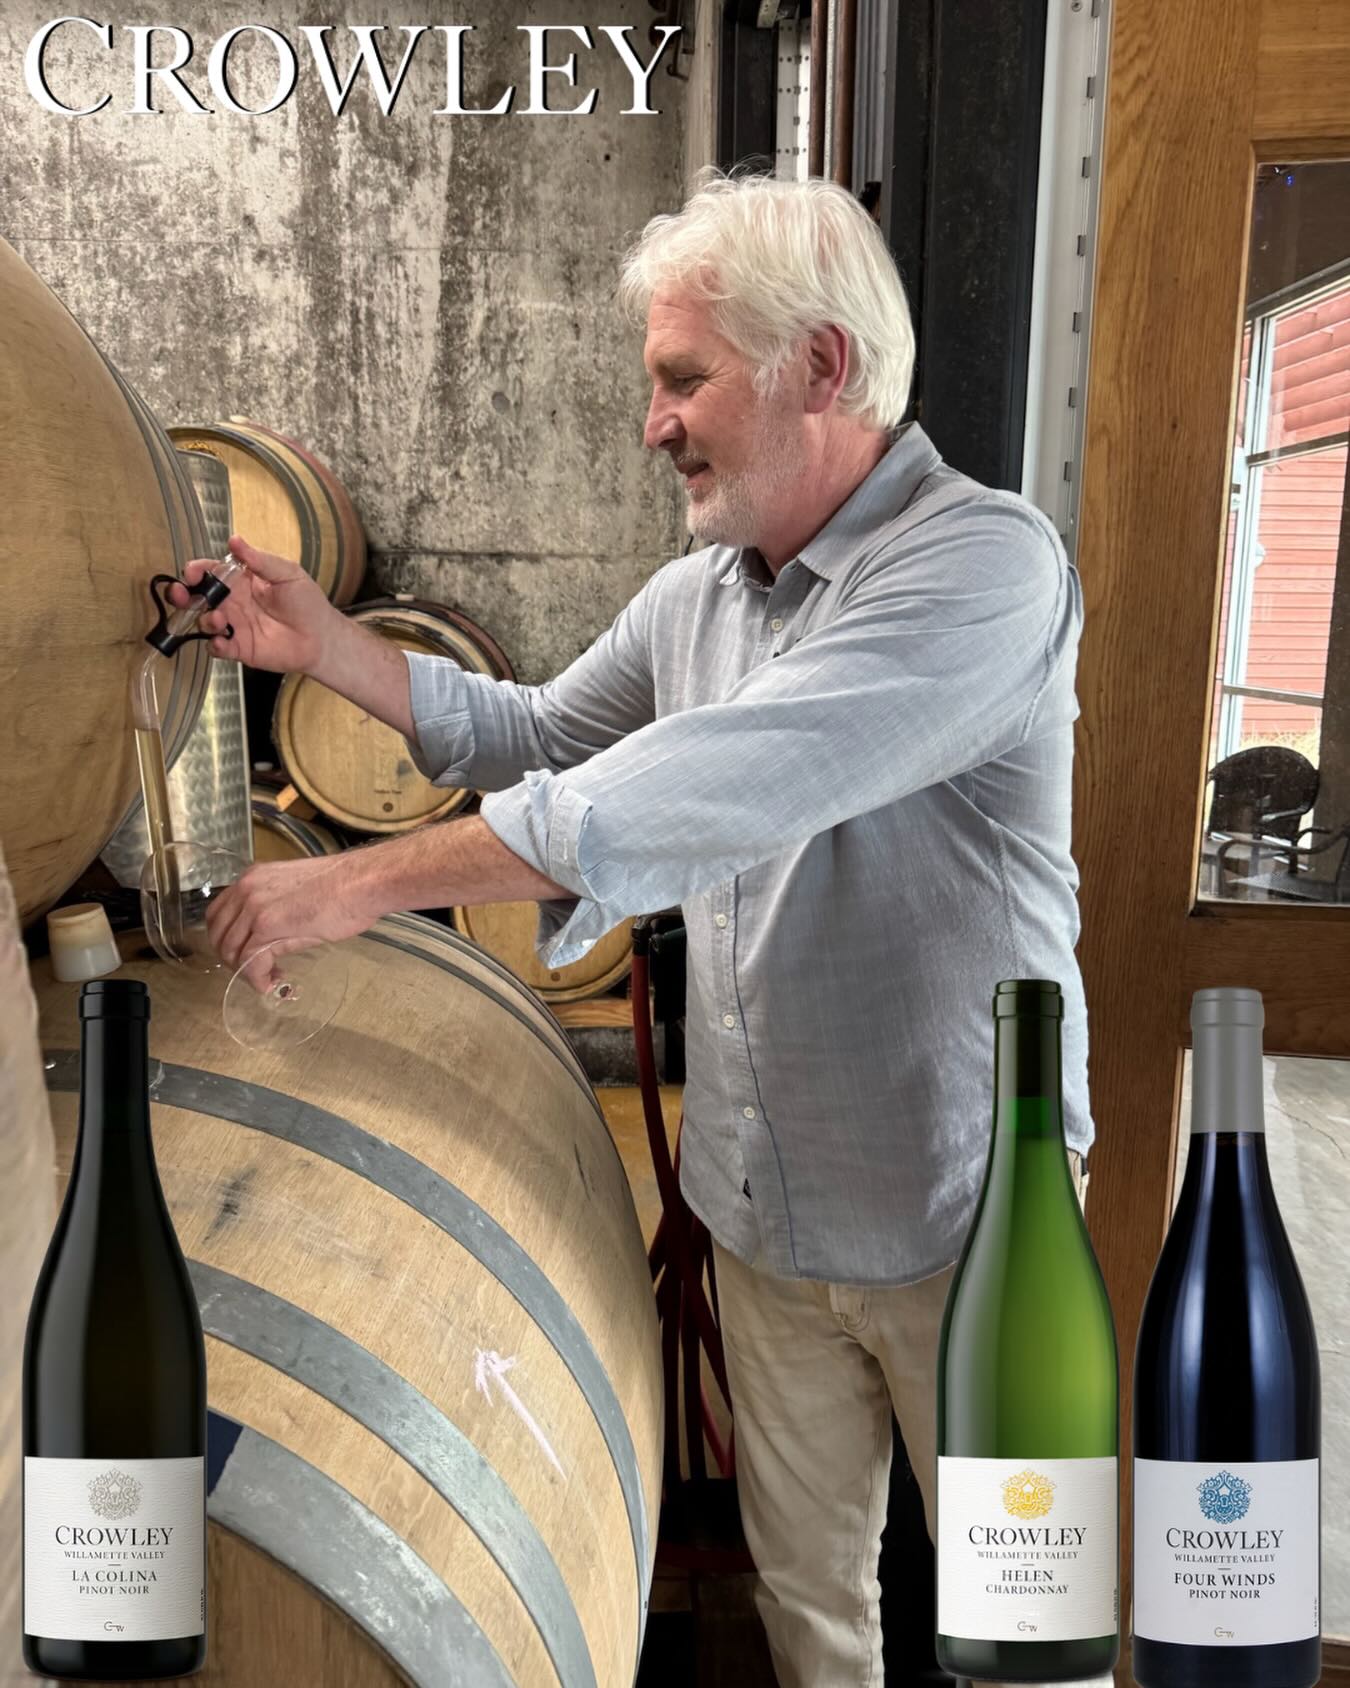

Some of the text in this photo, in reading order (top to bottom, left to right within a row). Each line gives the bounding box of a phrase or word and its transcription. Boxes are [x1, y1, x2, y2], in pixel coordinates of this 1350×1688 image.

[55, 1525, 174, 1546] CROWLEY
[968, 1525, 1087, 1546] CROWLEY
[1166, 1527, 1284, 1549] CROWLEY
[64, 1551, 166, 1560] WILLAMETTE VALLEY
[977, 1551, 1079, 1560] WILLAMETTE VALLEY
[1174, 1553, 1276, 1563] WILLAMETTE VALLEY
[72, 1570, 158, 1582] LA COLINA
[1001, 1570, 1054, 1582] HELEN
[1174, 1572, 1276, 1586] FOUR WINDS
[79, 1585, 150, 1595] PINOT NOIR
[986, 1585, 1069, 1594] CHARDONNAY
[1189, 1589, 1261, 1599] PINOT NOIR
